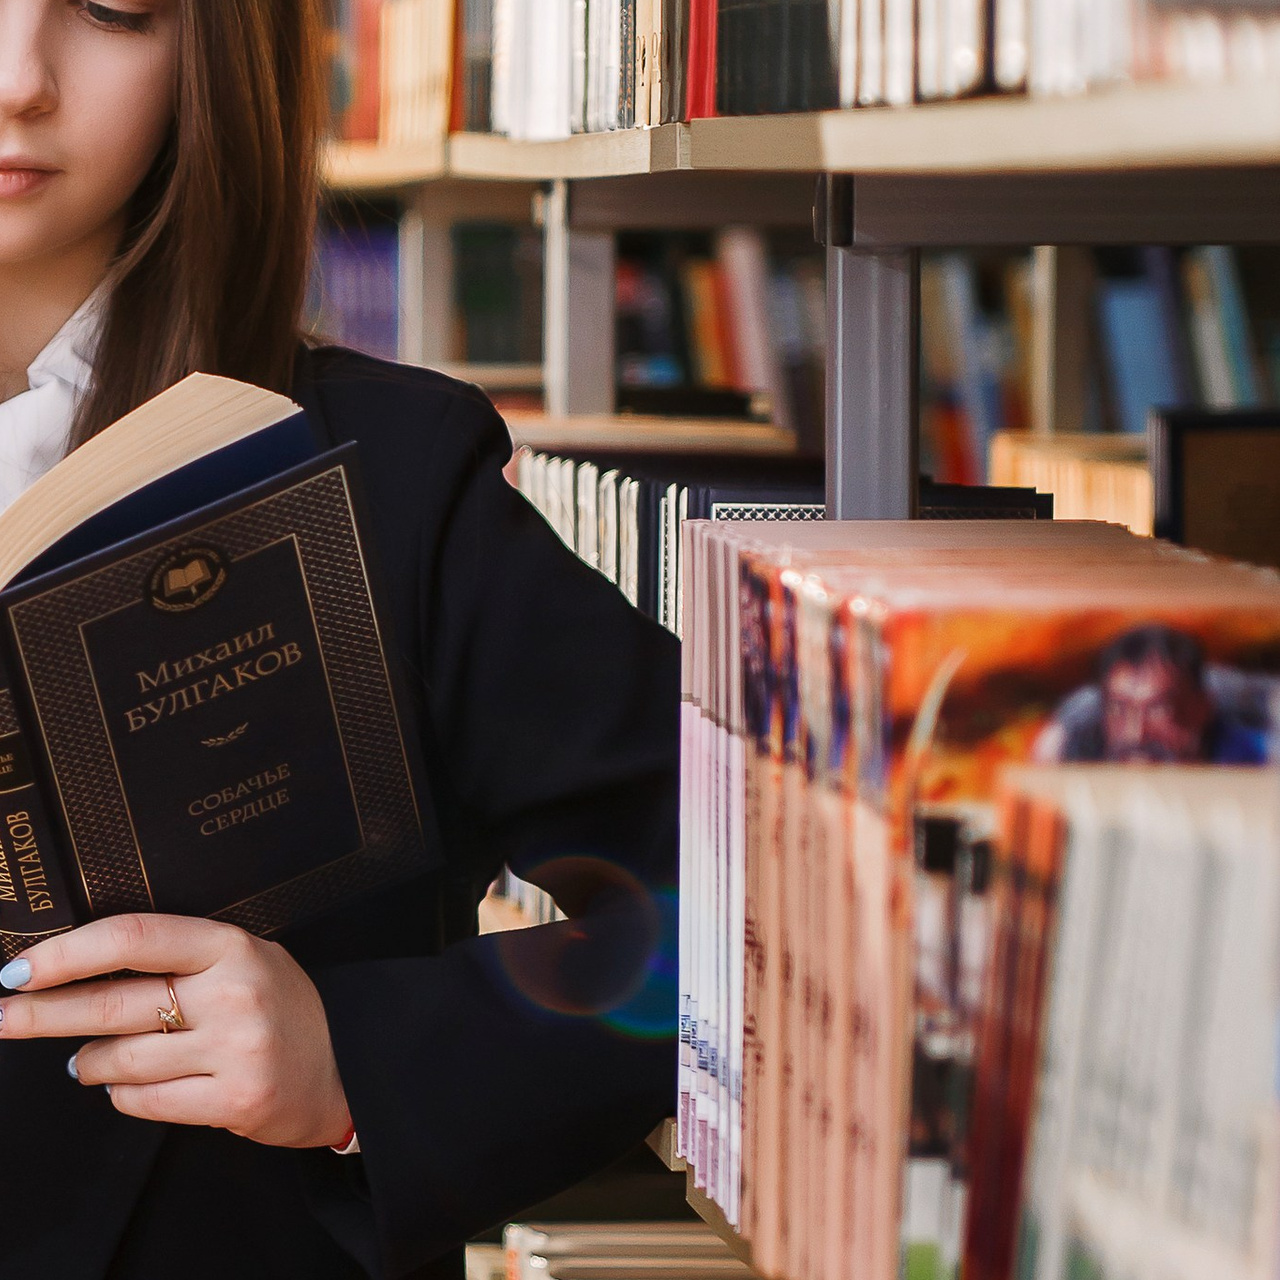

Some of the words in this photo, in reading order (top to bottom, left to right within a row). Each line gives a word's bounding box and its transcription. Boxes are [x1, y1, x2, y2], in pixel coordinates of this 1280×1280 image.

[124, 642, 303, 733] БУЛГАКОВ
[136, 622, 276, 693] Михаил
[188, 763, 291, 816] СОБАЧЬЕ
[200, 788, 290, 836] СЕРДЦЕ
[6, 811, 54, 912] БУЛГАКОВ
